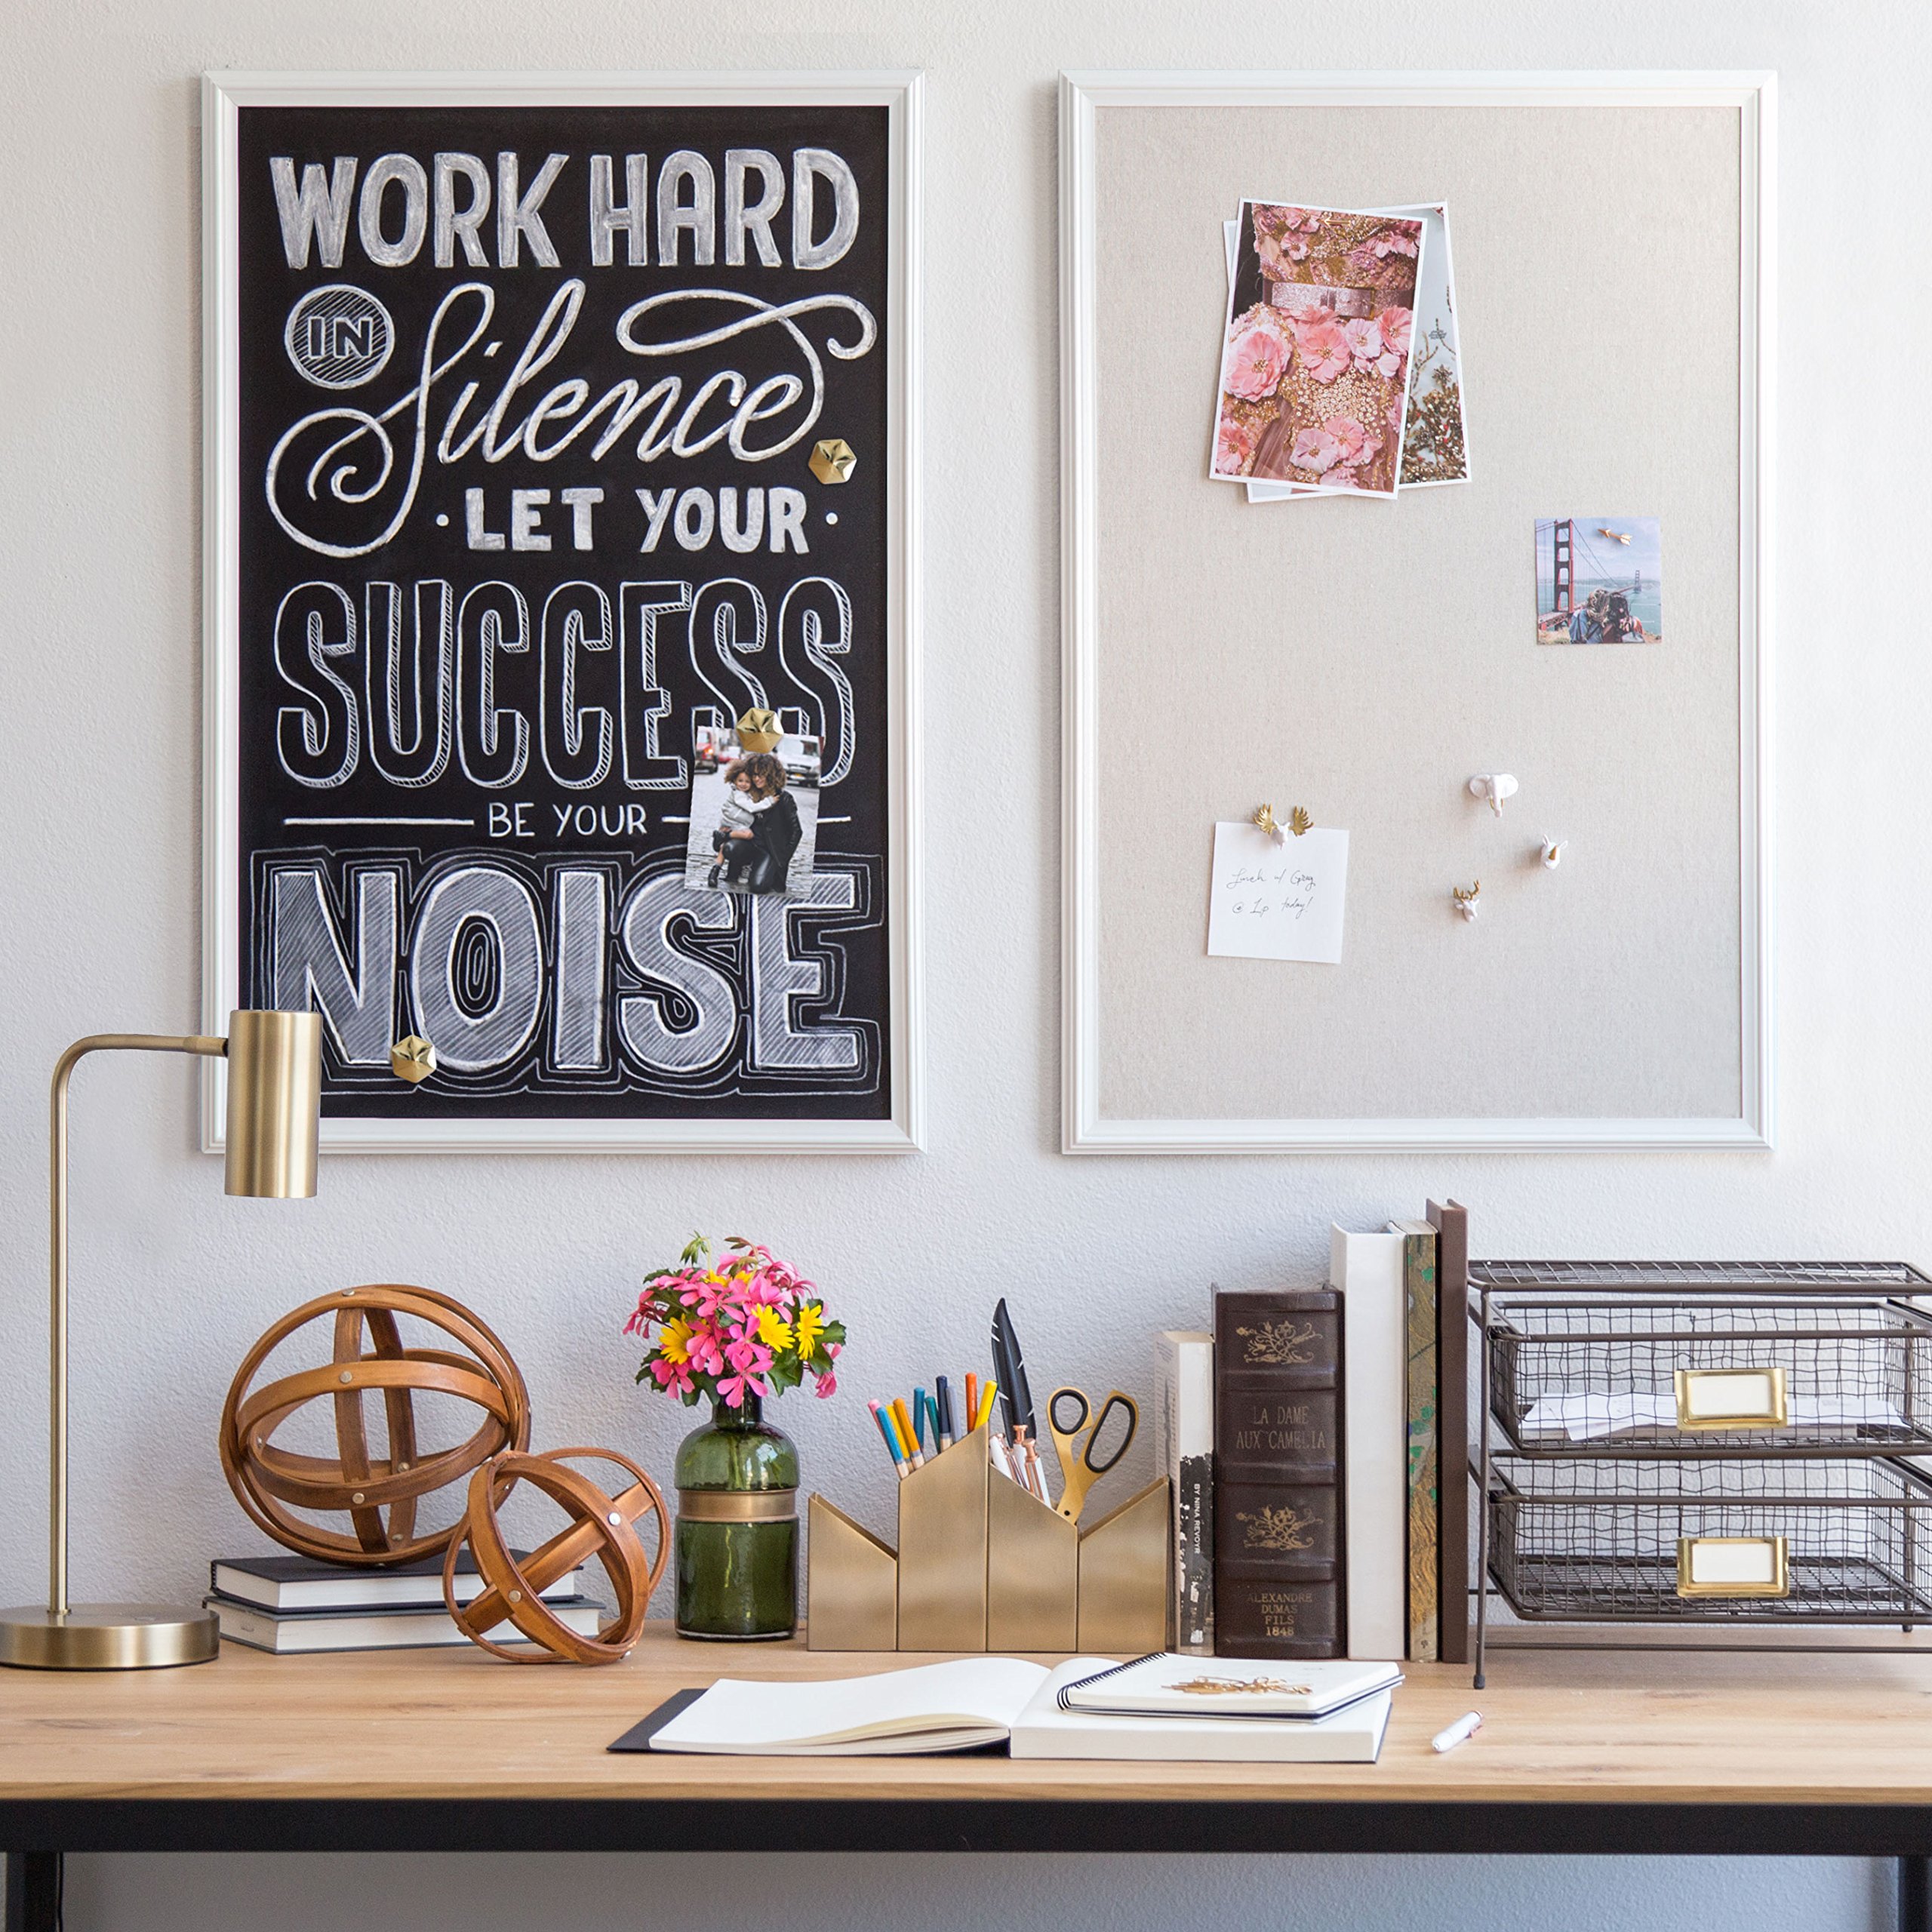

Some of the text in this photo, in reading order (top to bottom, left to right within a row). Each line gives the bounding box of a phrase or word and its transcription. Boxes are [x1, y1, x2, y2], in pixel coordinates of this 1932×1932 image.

[269, 148, 859, 270] WORK HARD
[266, 278, 876, 557] IN Silence
[466, 488, 810, 553] LET YOUR
[275, 577, 854, 789] SUCCESS
[488, 804, 647, 837] BE YOUR
[275, 867, 859, 1071] NOISE
[1254, 1406, 1309, 1425] LA DAME
[1236, 1431, 1261, 1449] AUX
[1194, 1484, 1200, 1495] BY
[1247, 1593, 1312, 1603] ALEXANDRE
[1261, 1604, 1298, 1614] DUMAS
[1266, 1615, 1294, 1625] FILS
[1266, 1626, 1294, 1637] 1848
